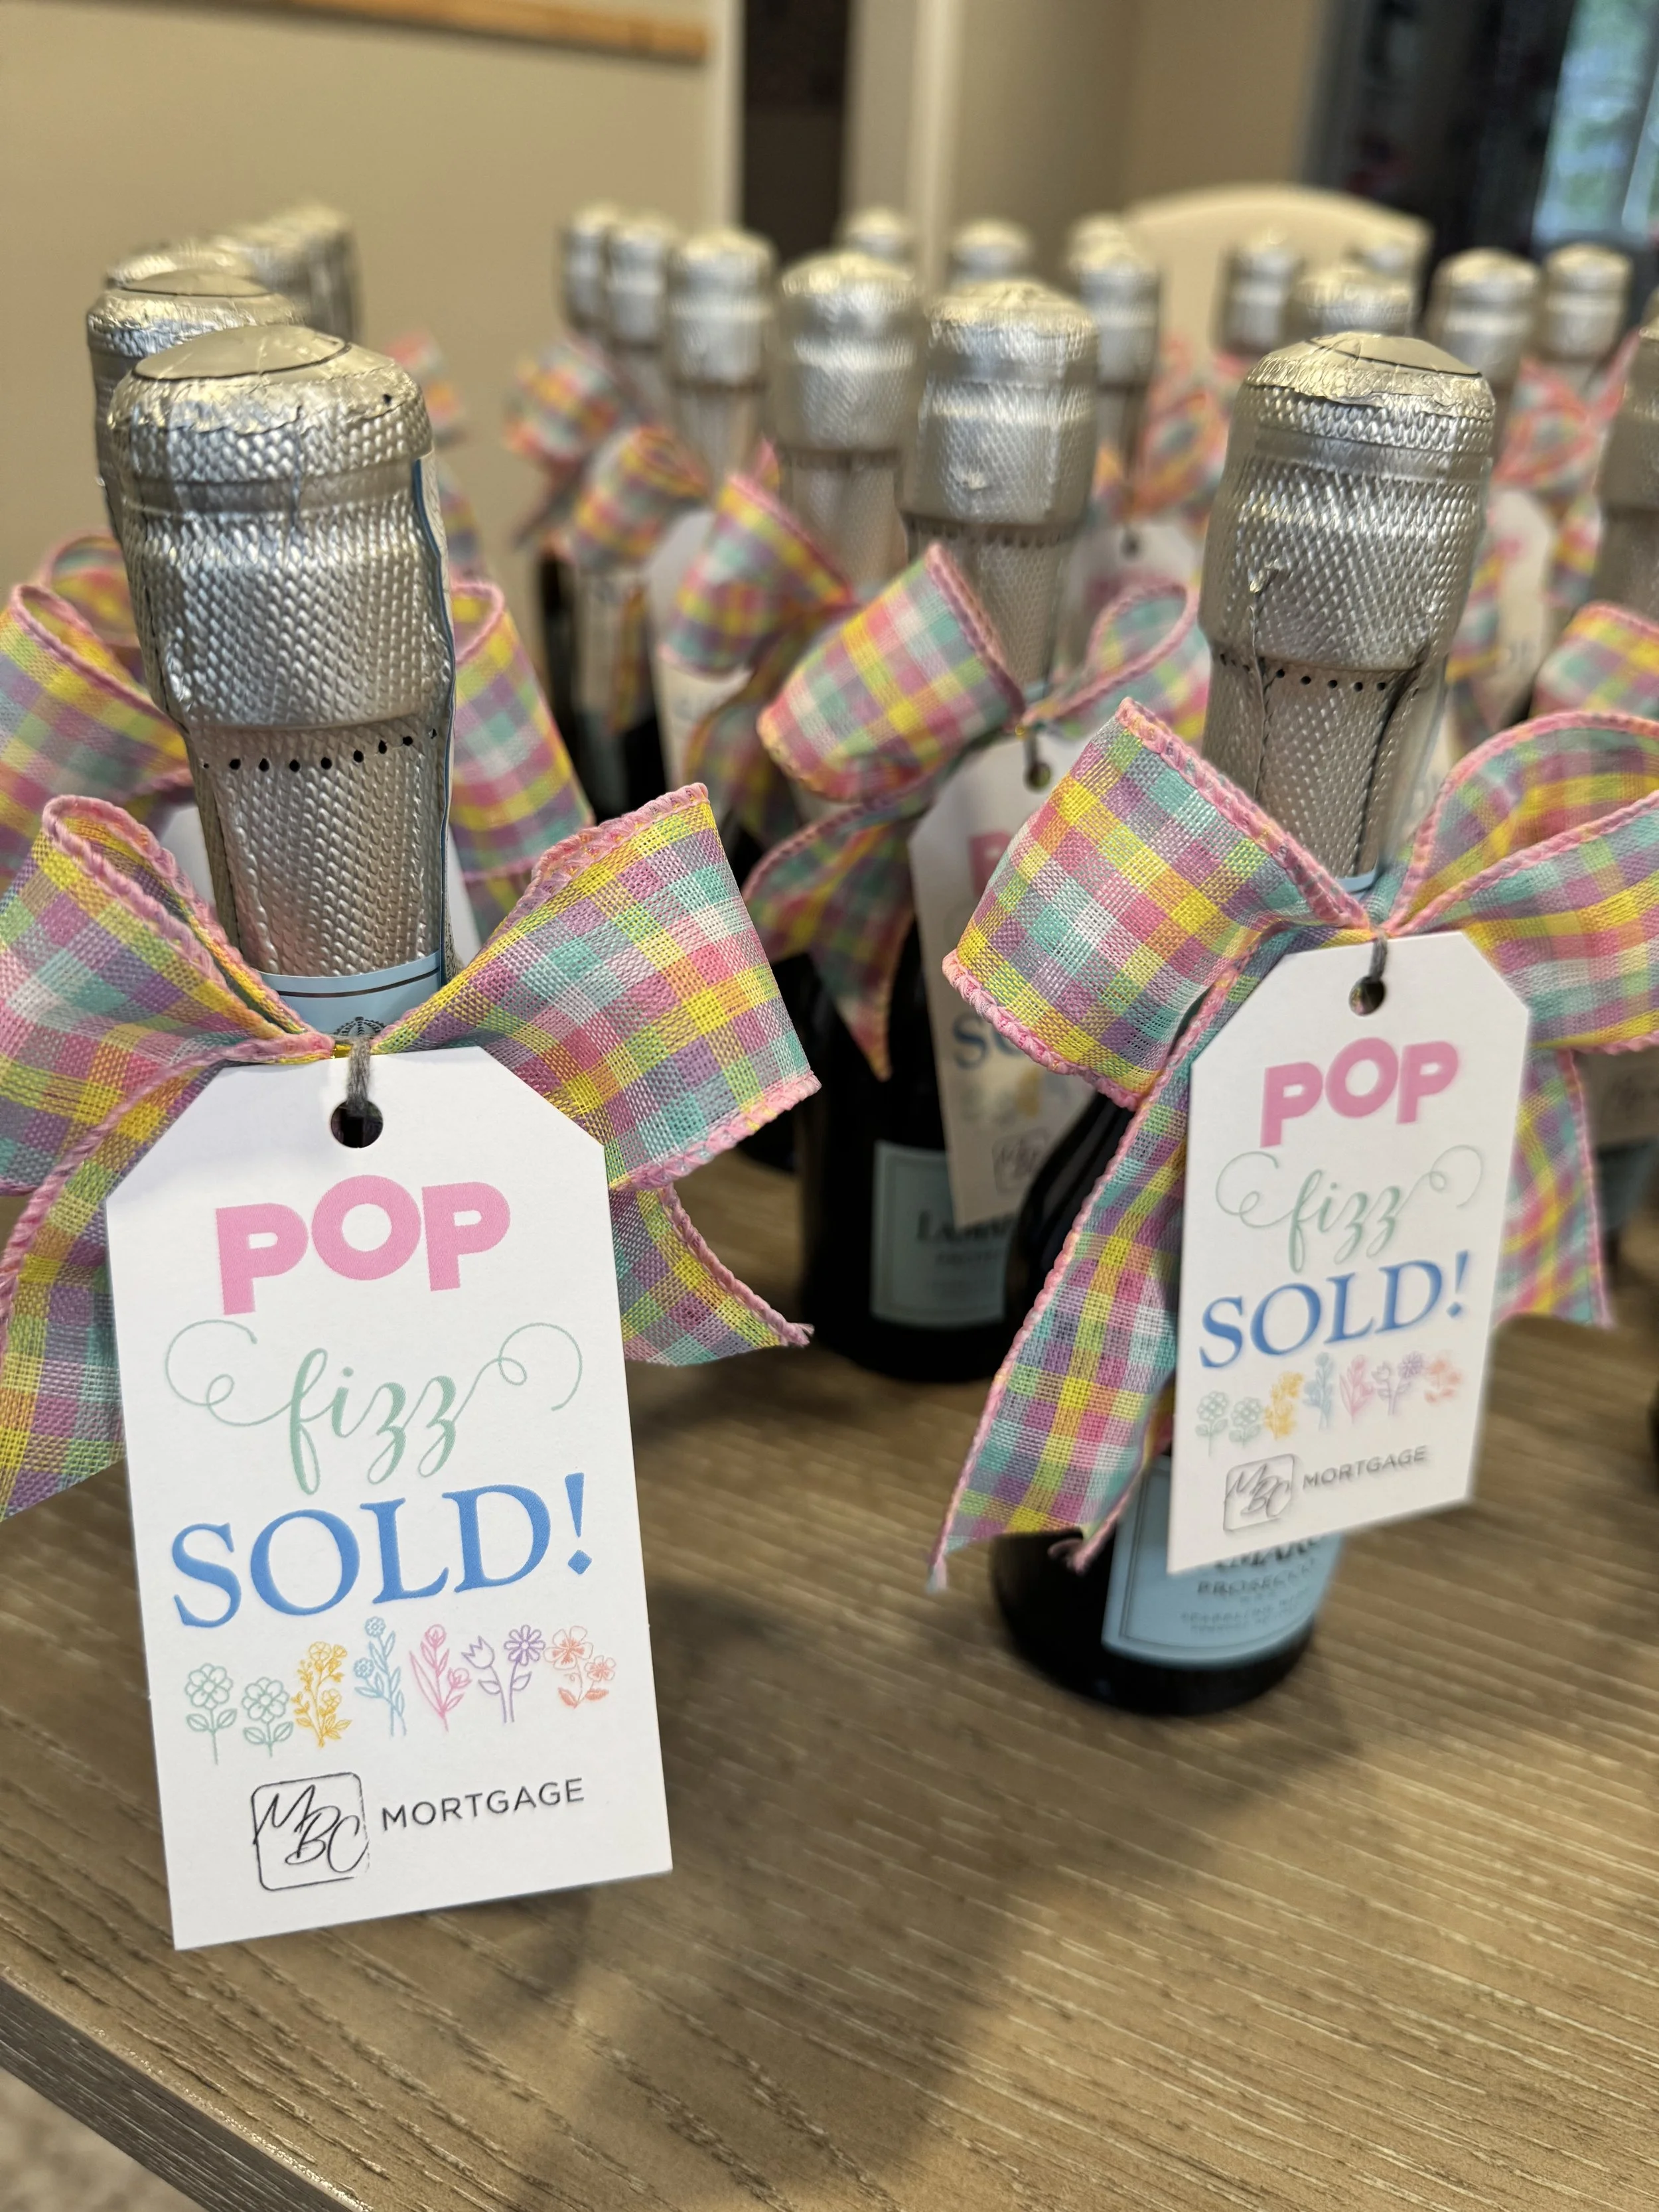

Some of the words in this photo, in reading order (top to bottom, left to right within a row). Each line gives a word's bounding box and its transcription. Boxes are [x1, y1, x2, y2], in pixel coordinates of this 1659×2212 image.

[1260, 1037, 1460, 1149] POP
[216, 1174, 511, 1316] POP
[1215, 1144, 1484, 1274] fizz
[1198, 1250, 1471, 1369] SOLD!
[165, 1319, 583, 1497] fizz
[1303, 1445, 1427, 1488] MORTGAGE
[170, 1472, 591, 1629] SOLD!
[252, 1783, 370, 1877] MBC
[380, 1778, 584, 1832] MORTGAGE
